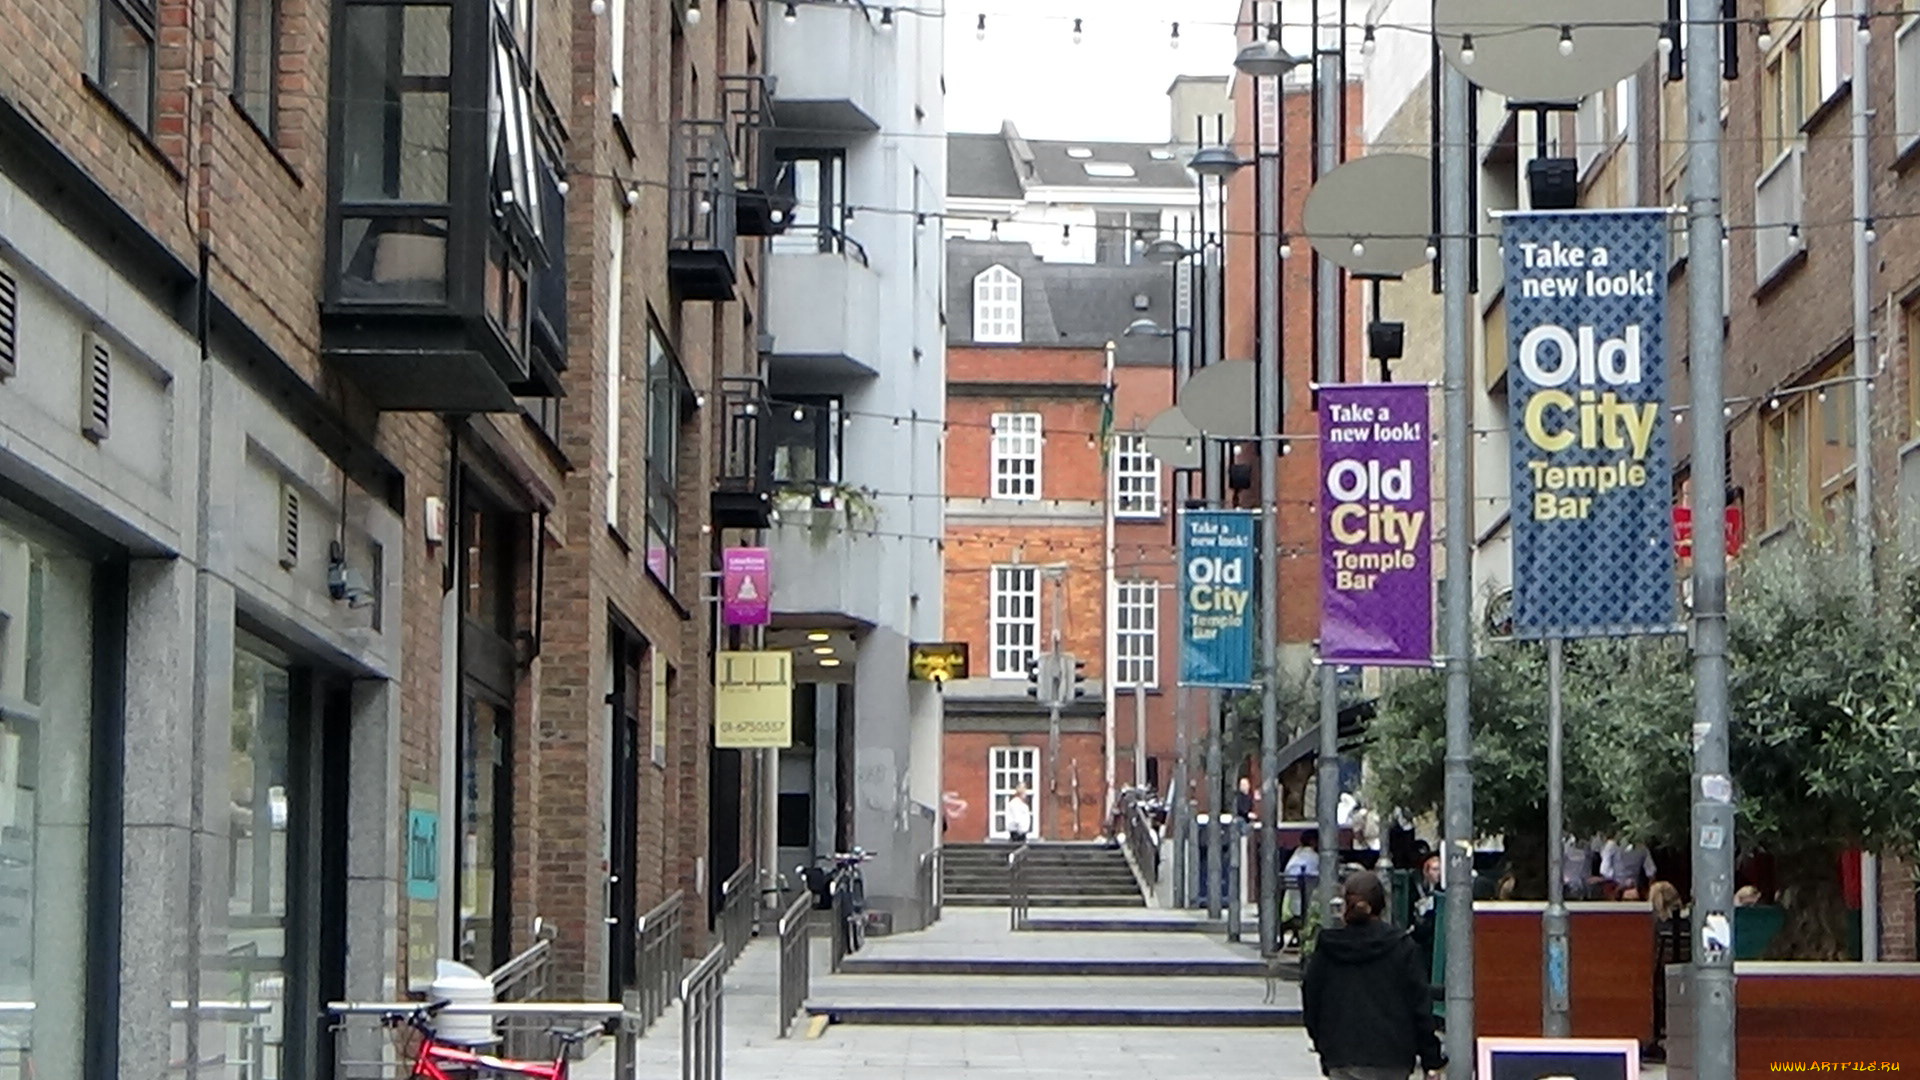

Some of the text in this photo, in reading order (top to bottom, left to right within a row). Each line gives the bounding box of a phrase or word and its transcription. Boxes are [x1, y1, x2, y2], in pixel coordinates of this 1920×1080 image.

[1519, 242, 1608, 268] Take a
[1522, 270, 1655, 298] new look!
[1519, 324, 1641, 387] Old
[1329, 404, 1390, 422] Take a
[1524, 389, 1658, 461] City
[1331, 422, 1421, 442] new look!
[1327, 459, 1412, 501] Old
[1529, 460, 1646, 494] Temple
[1534, 492, 1592, 521] Bar
[1330, 503, 1425, 551] City
[1188, 557, 1242, 584] Old
[1333, 550, 1416, 573] Temple
[1336, 571, 1377, 591] Bar
[1190, 584, 1249, 615] City
